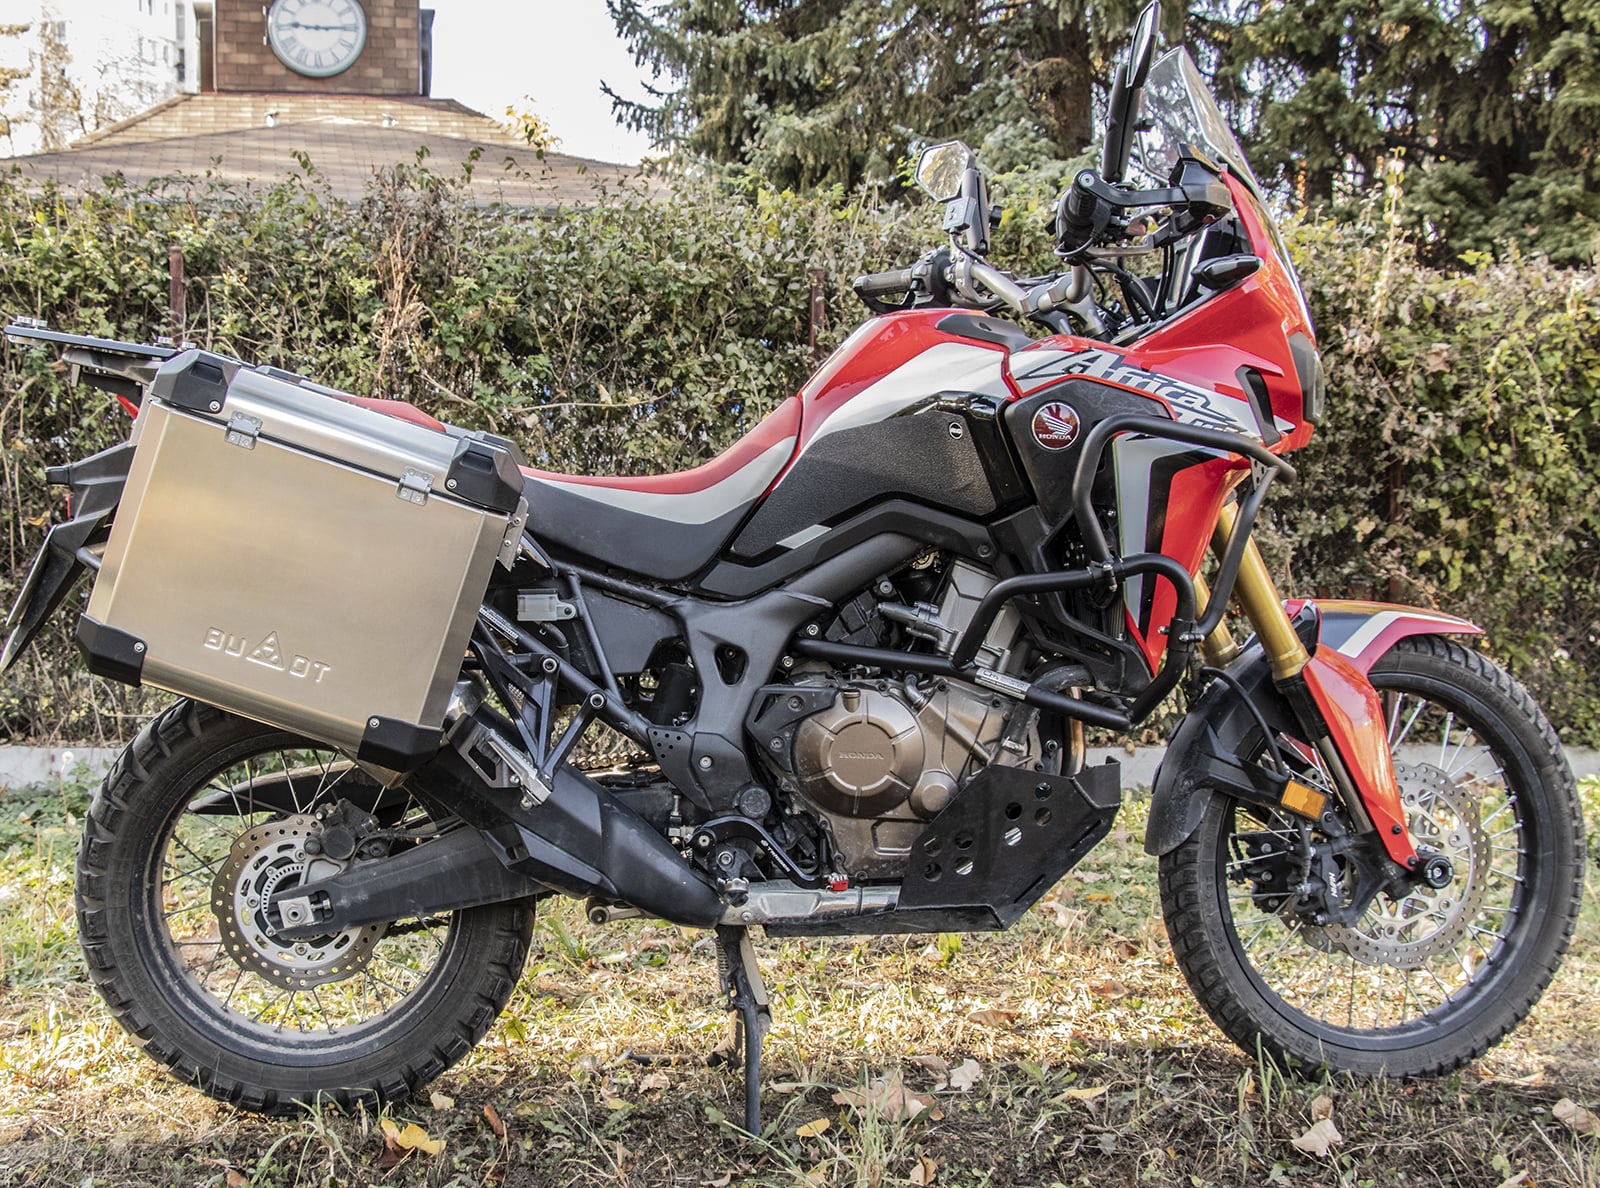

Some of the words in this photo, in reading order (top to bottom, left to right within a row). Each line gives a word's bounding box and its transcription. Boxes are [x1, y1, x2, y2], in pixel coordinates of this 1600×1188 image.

[1062, 347, 1207, 410] Africa
[1038, 433, 1073, 441] HONDA
[839, 751, 885, 760] HONDA
